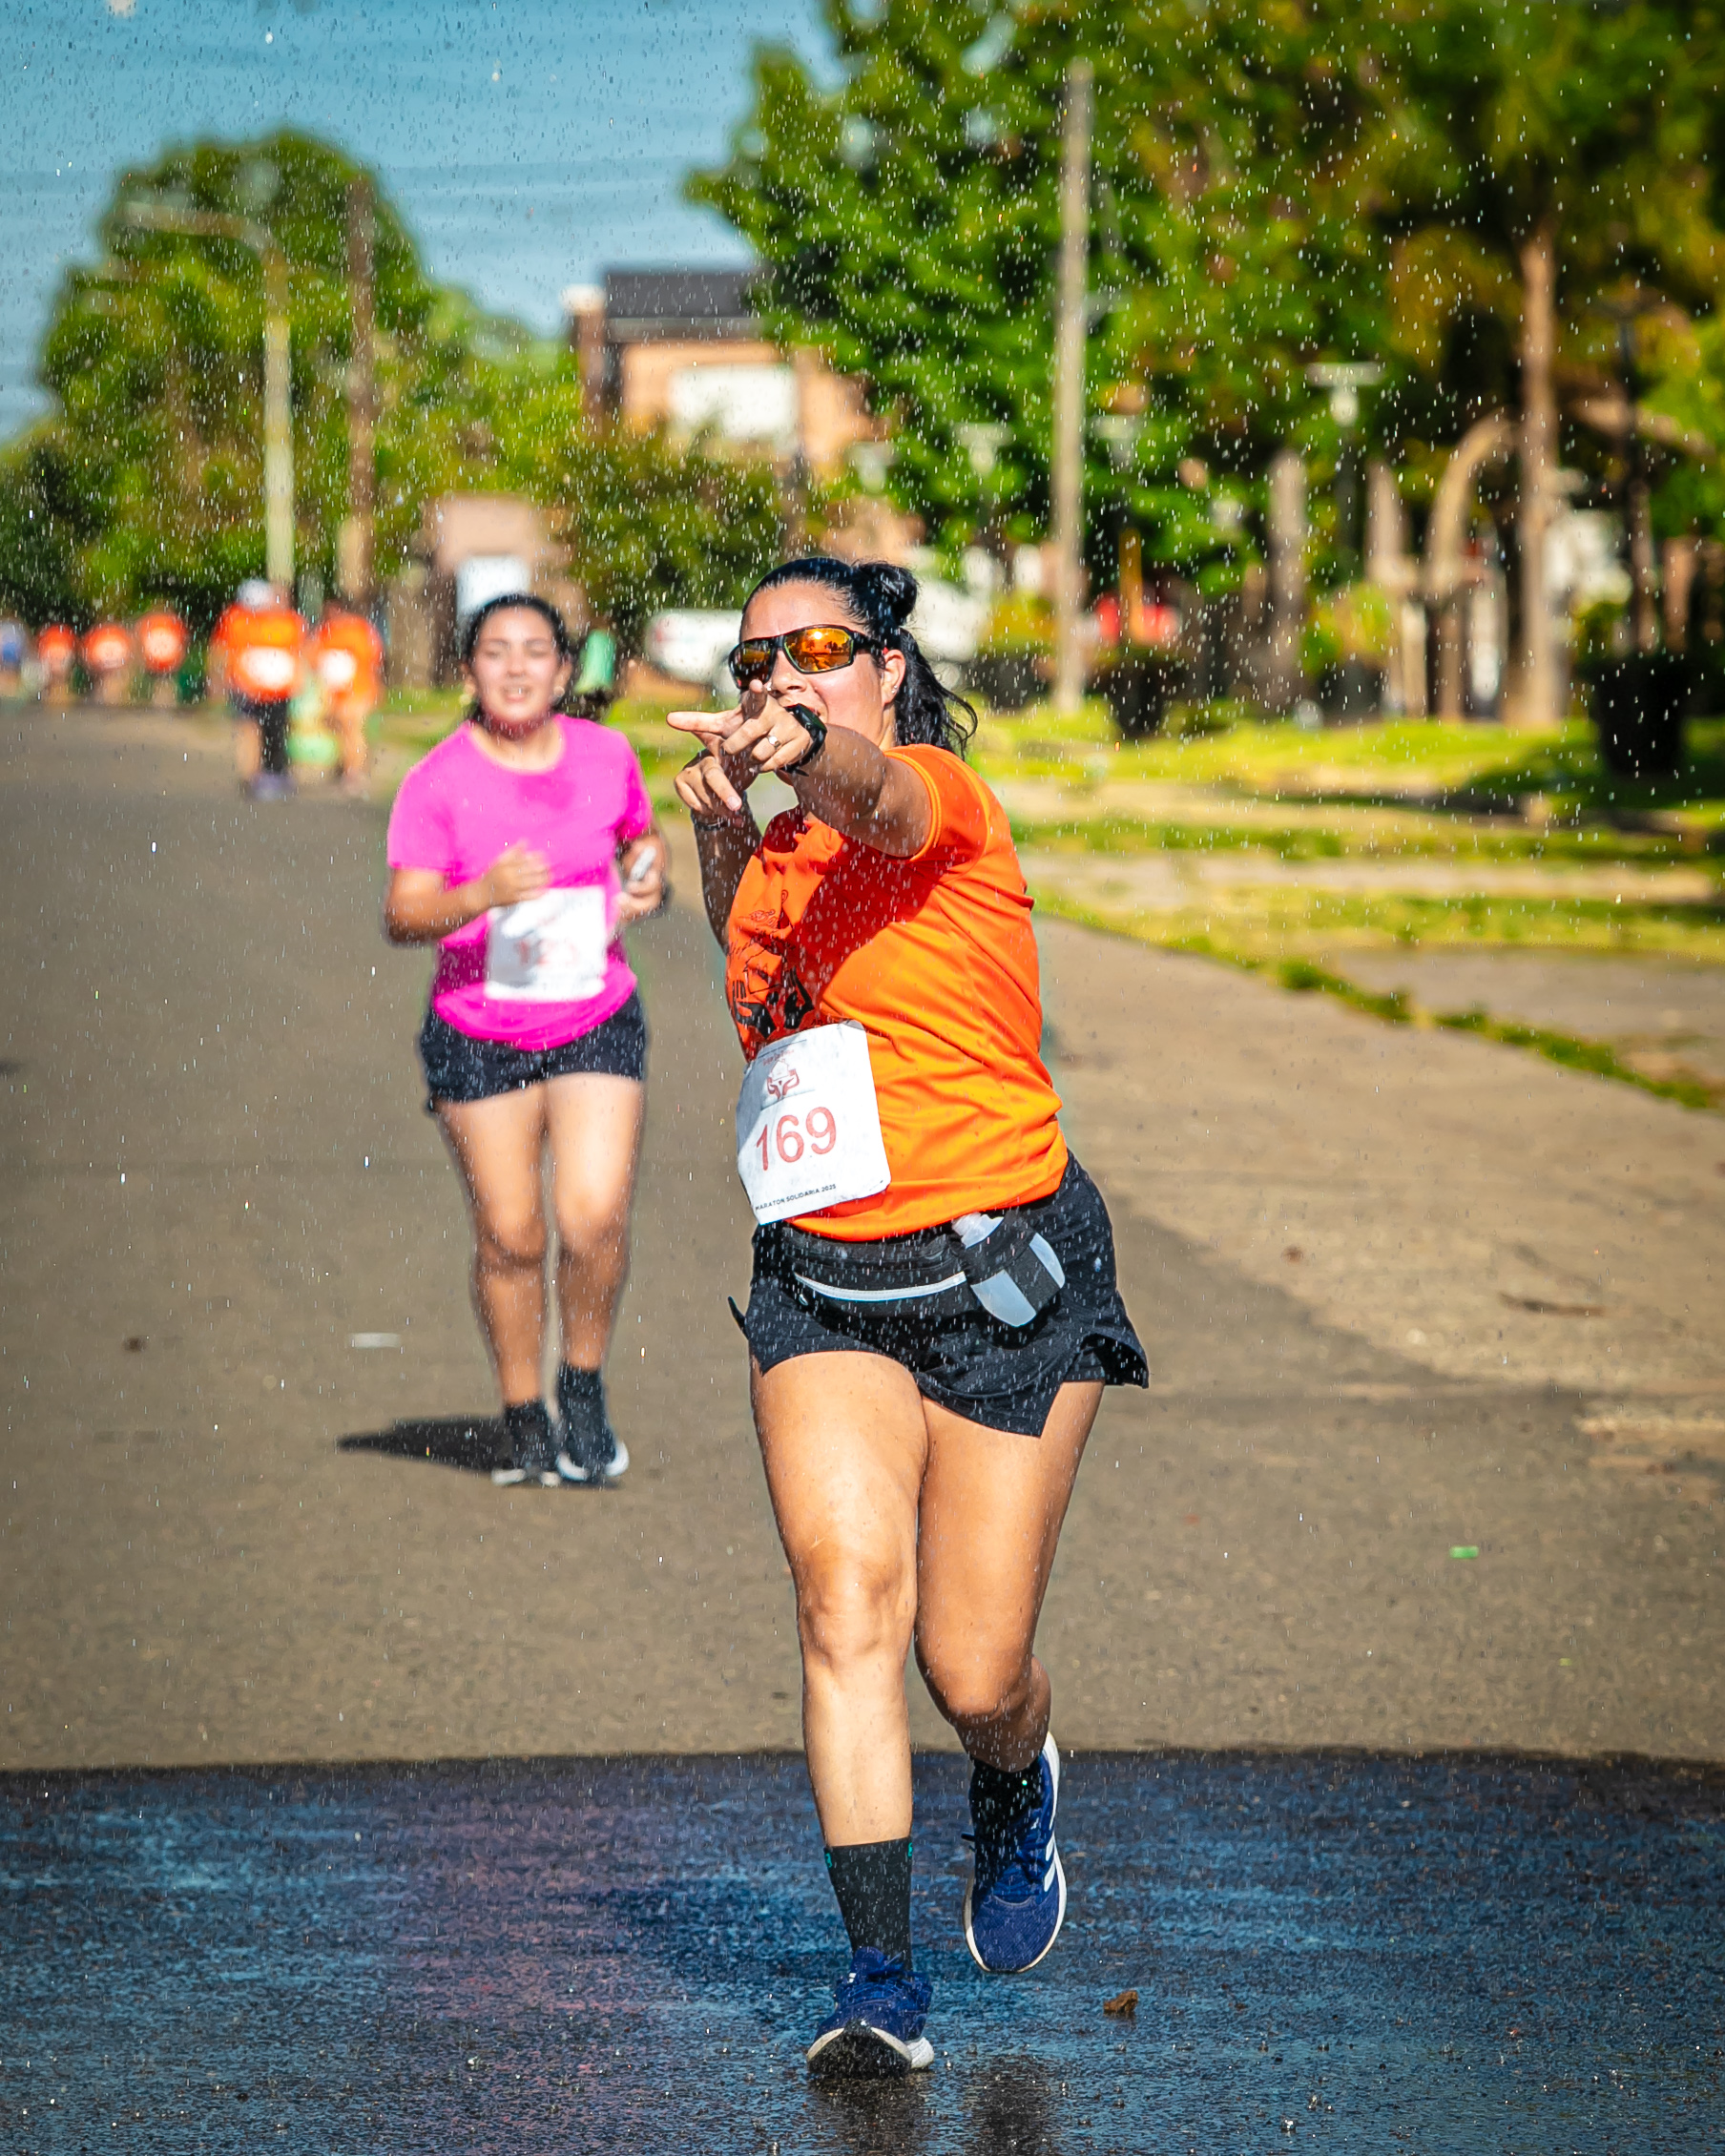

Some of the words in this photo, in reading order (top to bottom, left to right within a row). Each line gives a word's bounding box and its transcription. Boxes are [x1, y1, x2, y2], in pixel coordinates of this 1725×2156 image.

[757, 1107, 837, 1171] 169
[786, 1188, 821, 1202] SOLIDARIA
[821, 1183, 837, 1192] 2025
